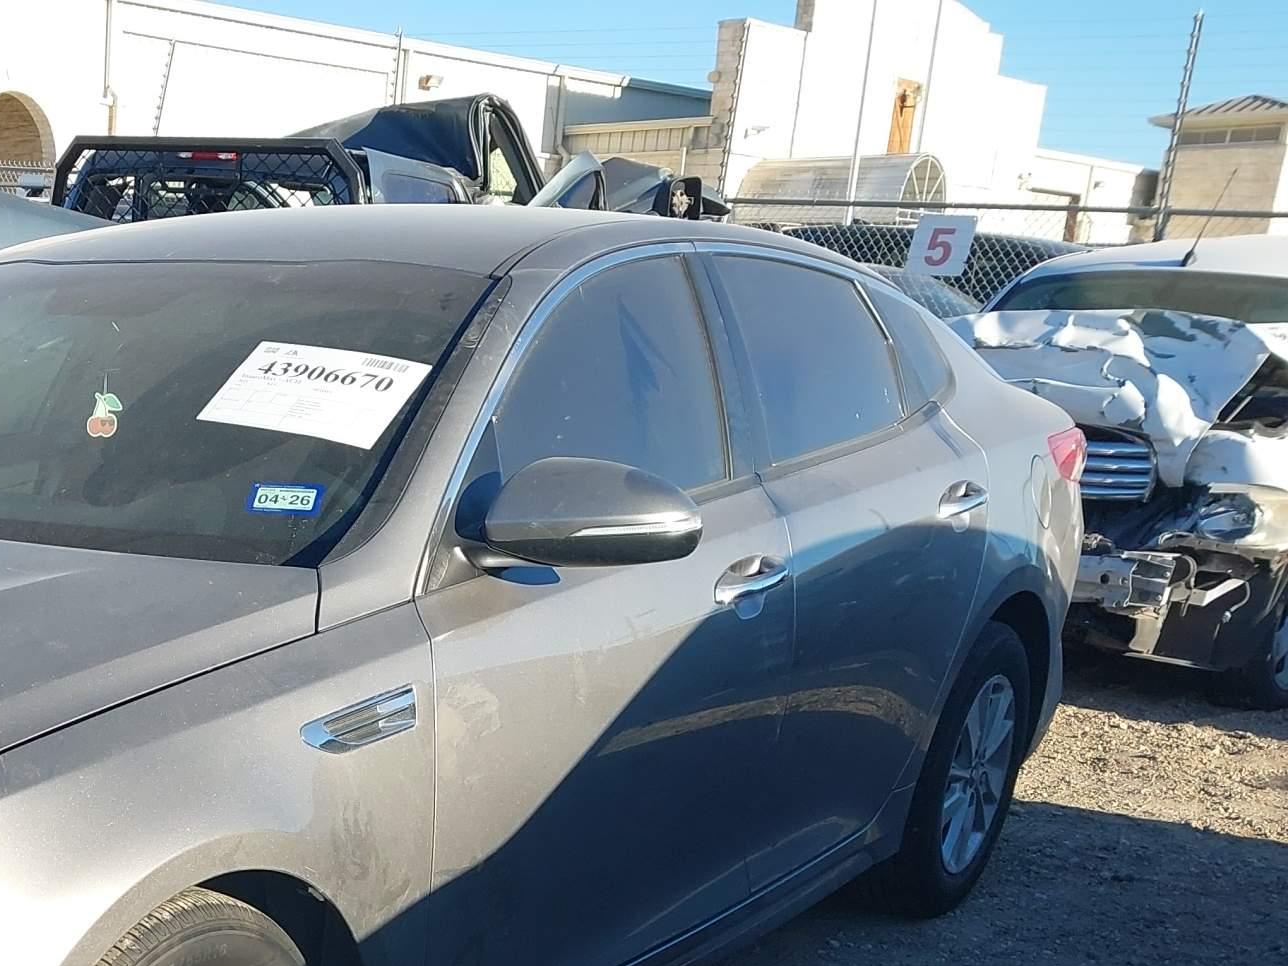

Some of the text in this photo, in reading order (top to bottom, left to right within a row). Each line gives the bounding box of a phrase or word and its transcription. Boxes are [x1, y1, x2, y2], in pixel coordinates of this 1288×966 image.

[924, 227, 957, 267] 5
[257, 359, 394, 393] 43906670
[257, 493, 312, 506] 04 26
